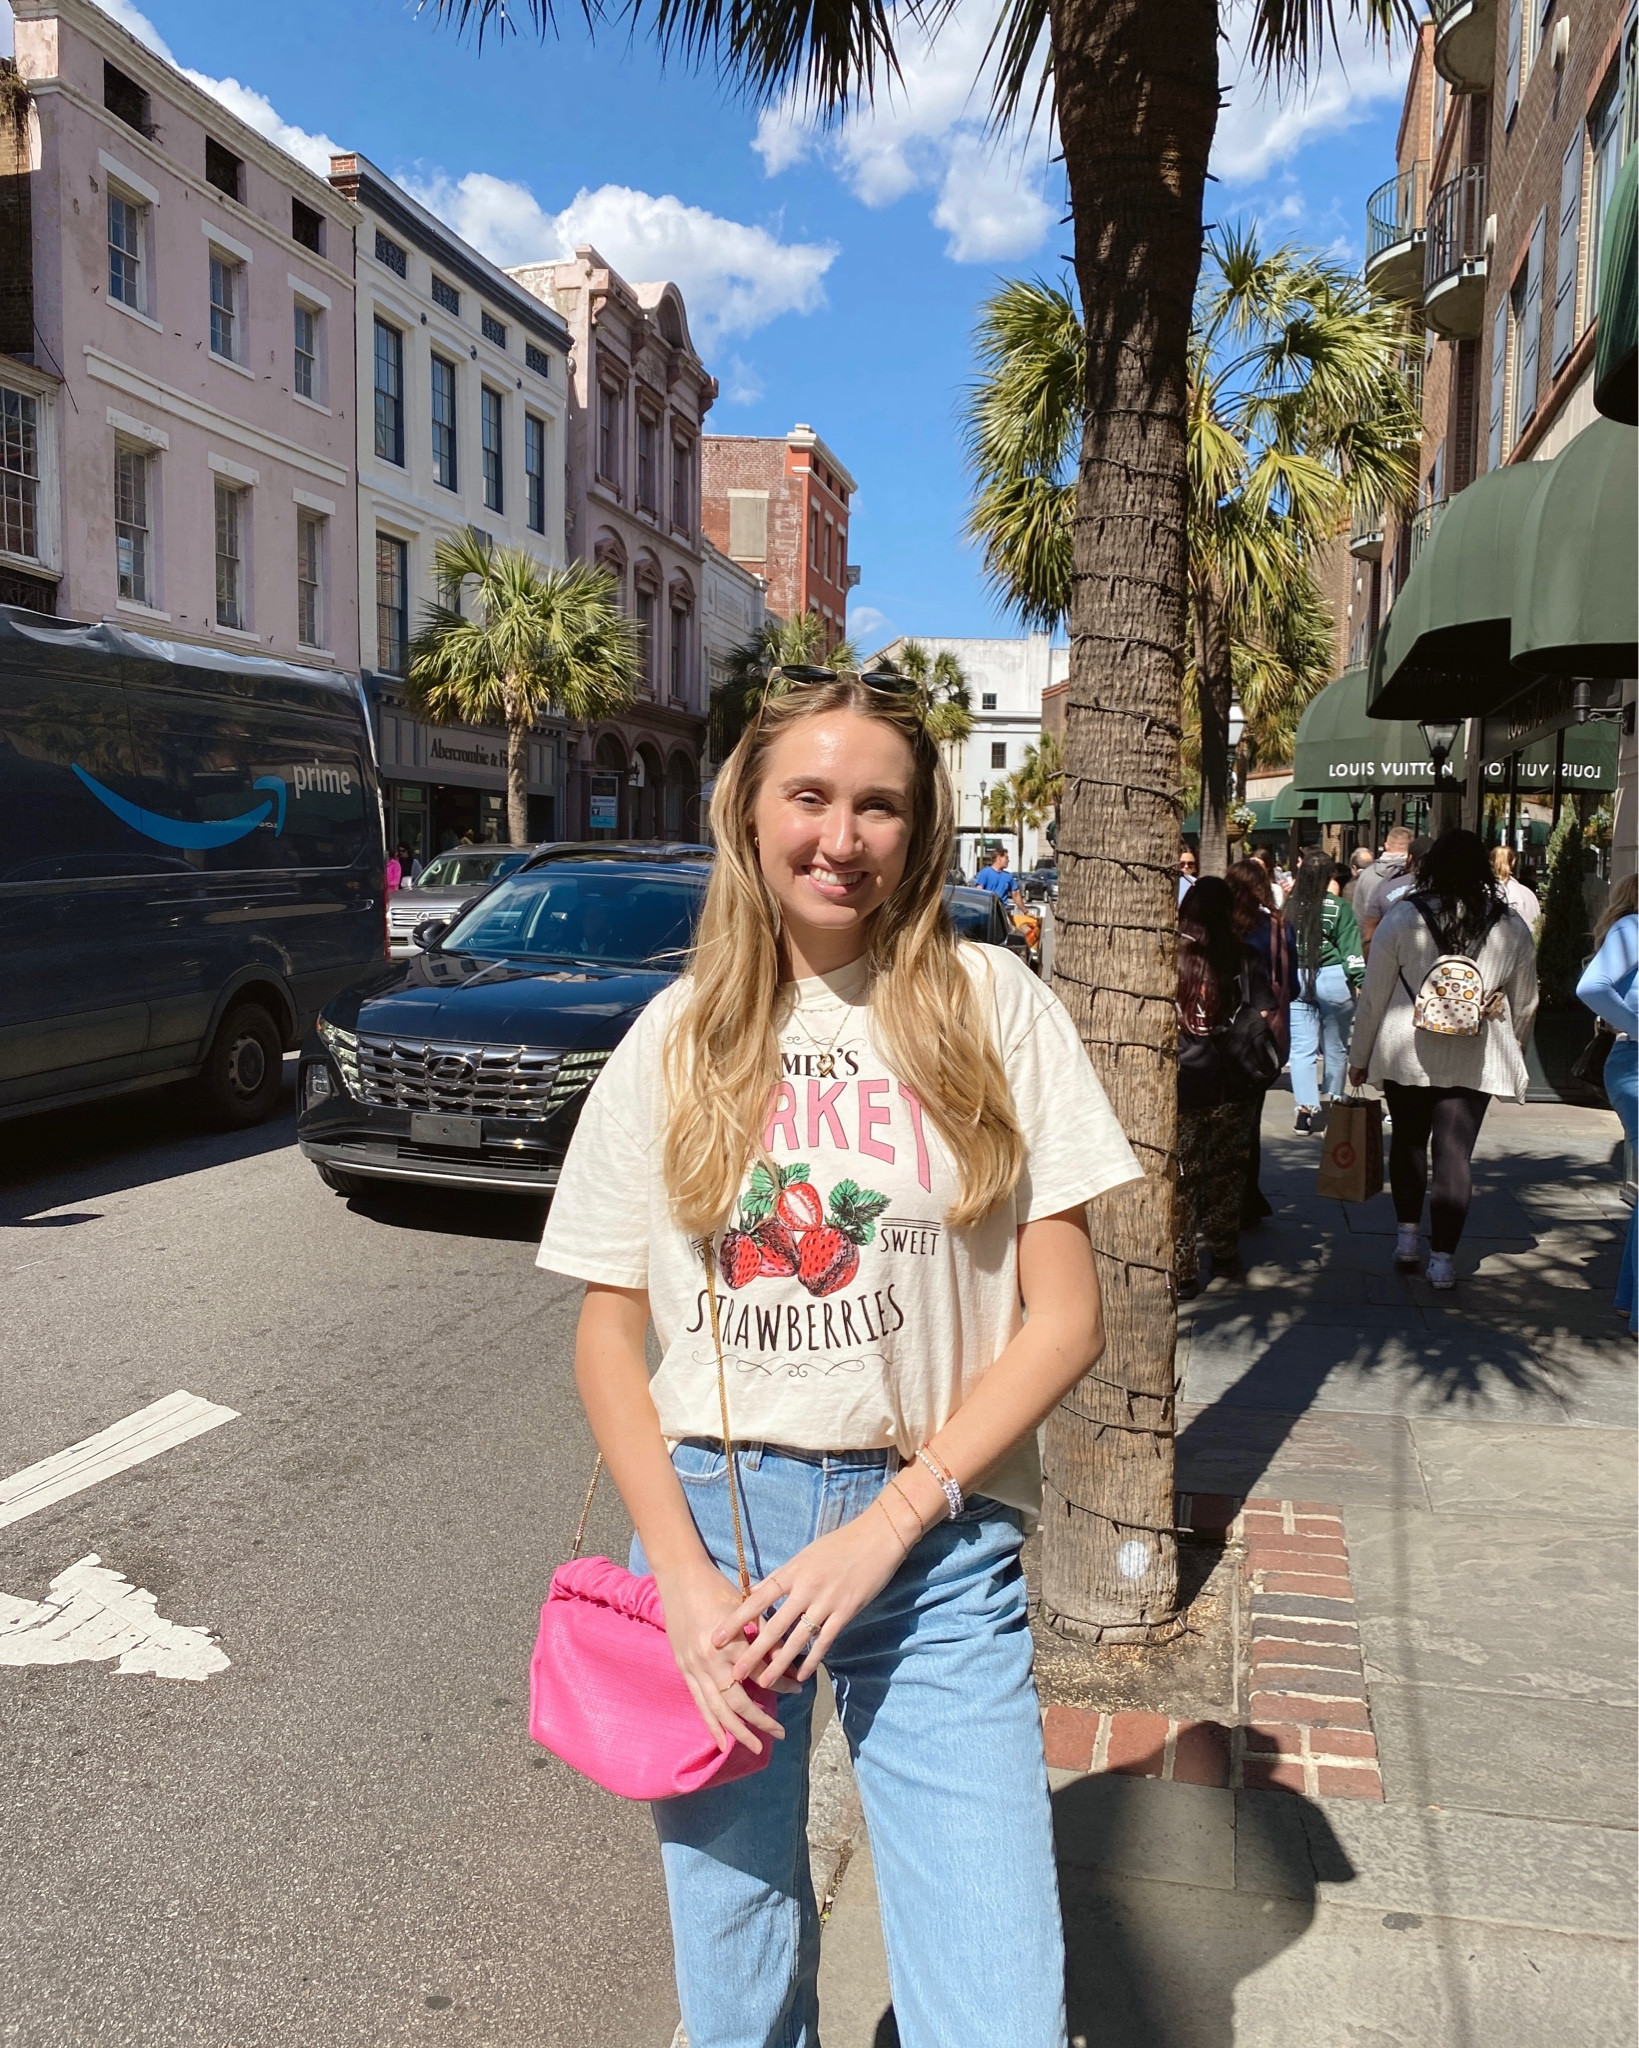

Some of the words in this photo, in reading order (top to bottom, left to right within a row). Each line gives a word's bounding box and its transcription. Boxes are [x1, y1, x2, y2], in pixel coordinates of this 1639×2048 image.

[430, 737, 489, 766] Abercrombie
[490, 752, 498, 767] &
[293, 758, 351, 799] prime
[1329, 762, 1375, 777] LOUIS
[1381, 761, 1454, 776] VUITTON
[780, 1048, 859, 1079] MER'S
[763, 1079, 931, 1193] RKET
[880, 1228, 940, 1256] SWEET
[686, 1283, 904, 1351] STRAWBERRIES
